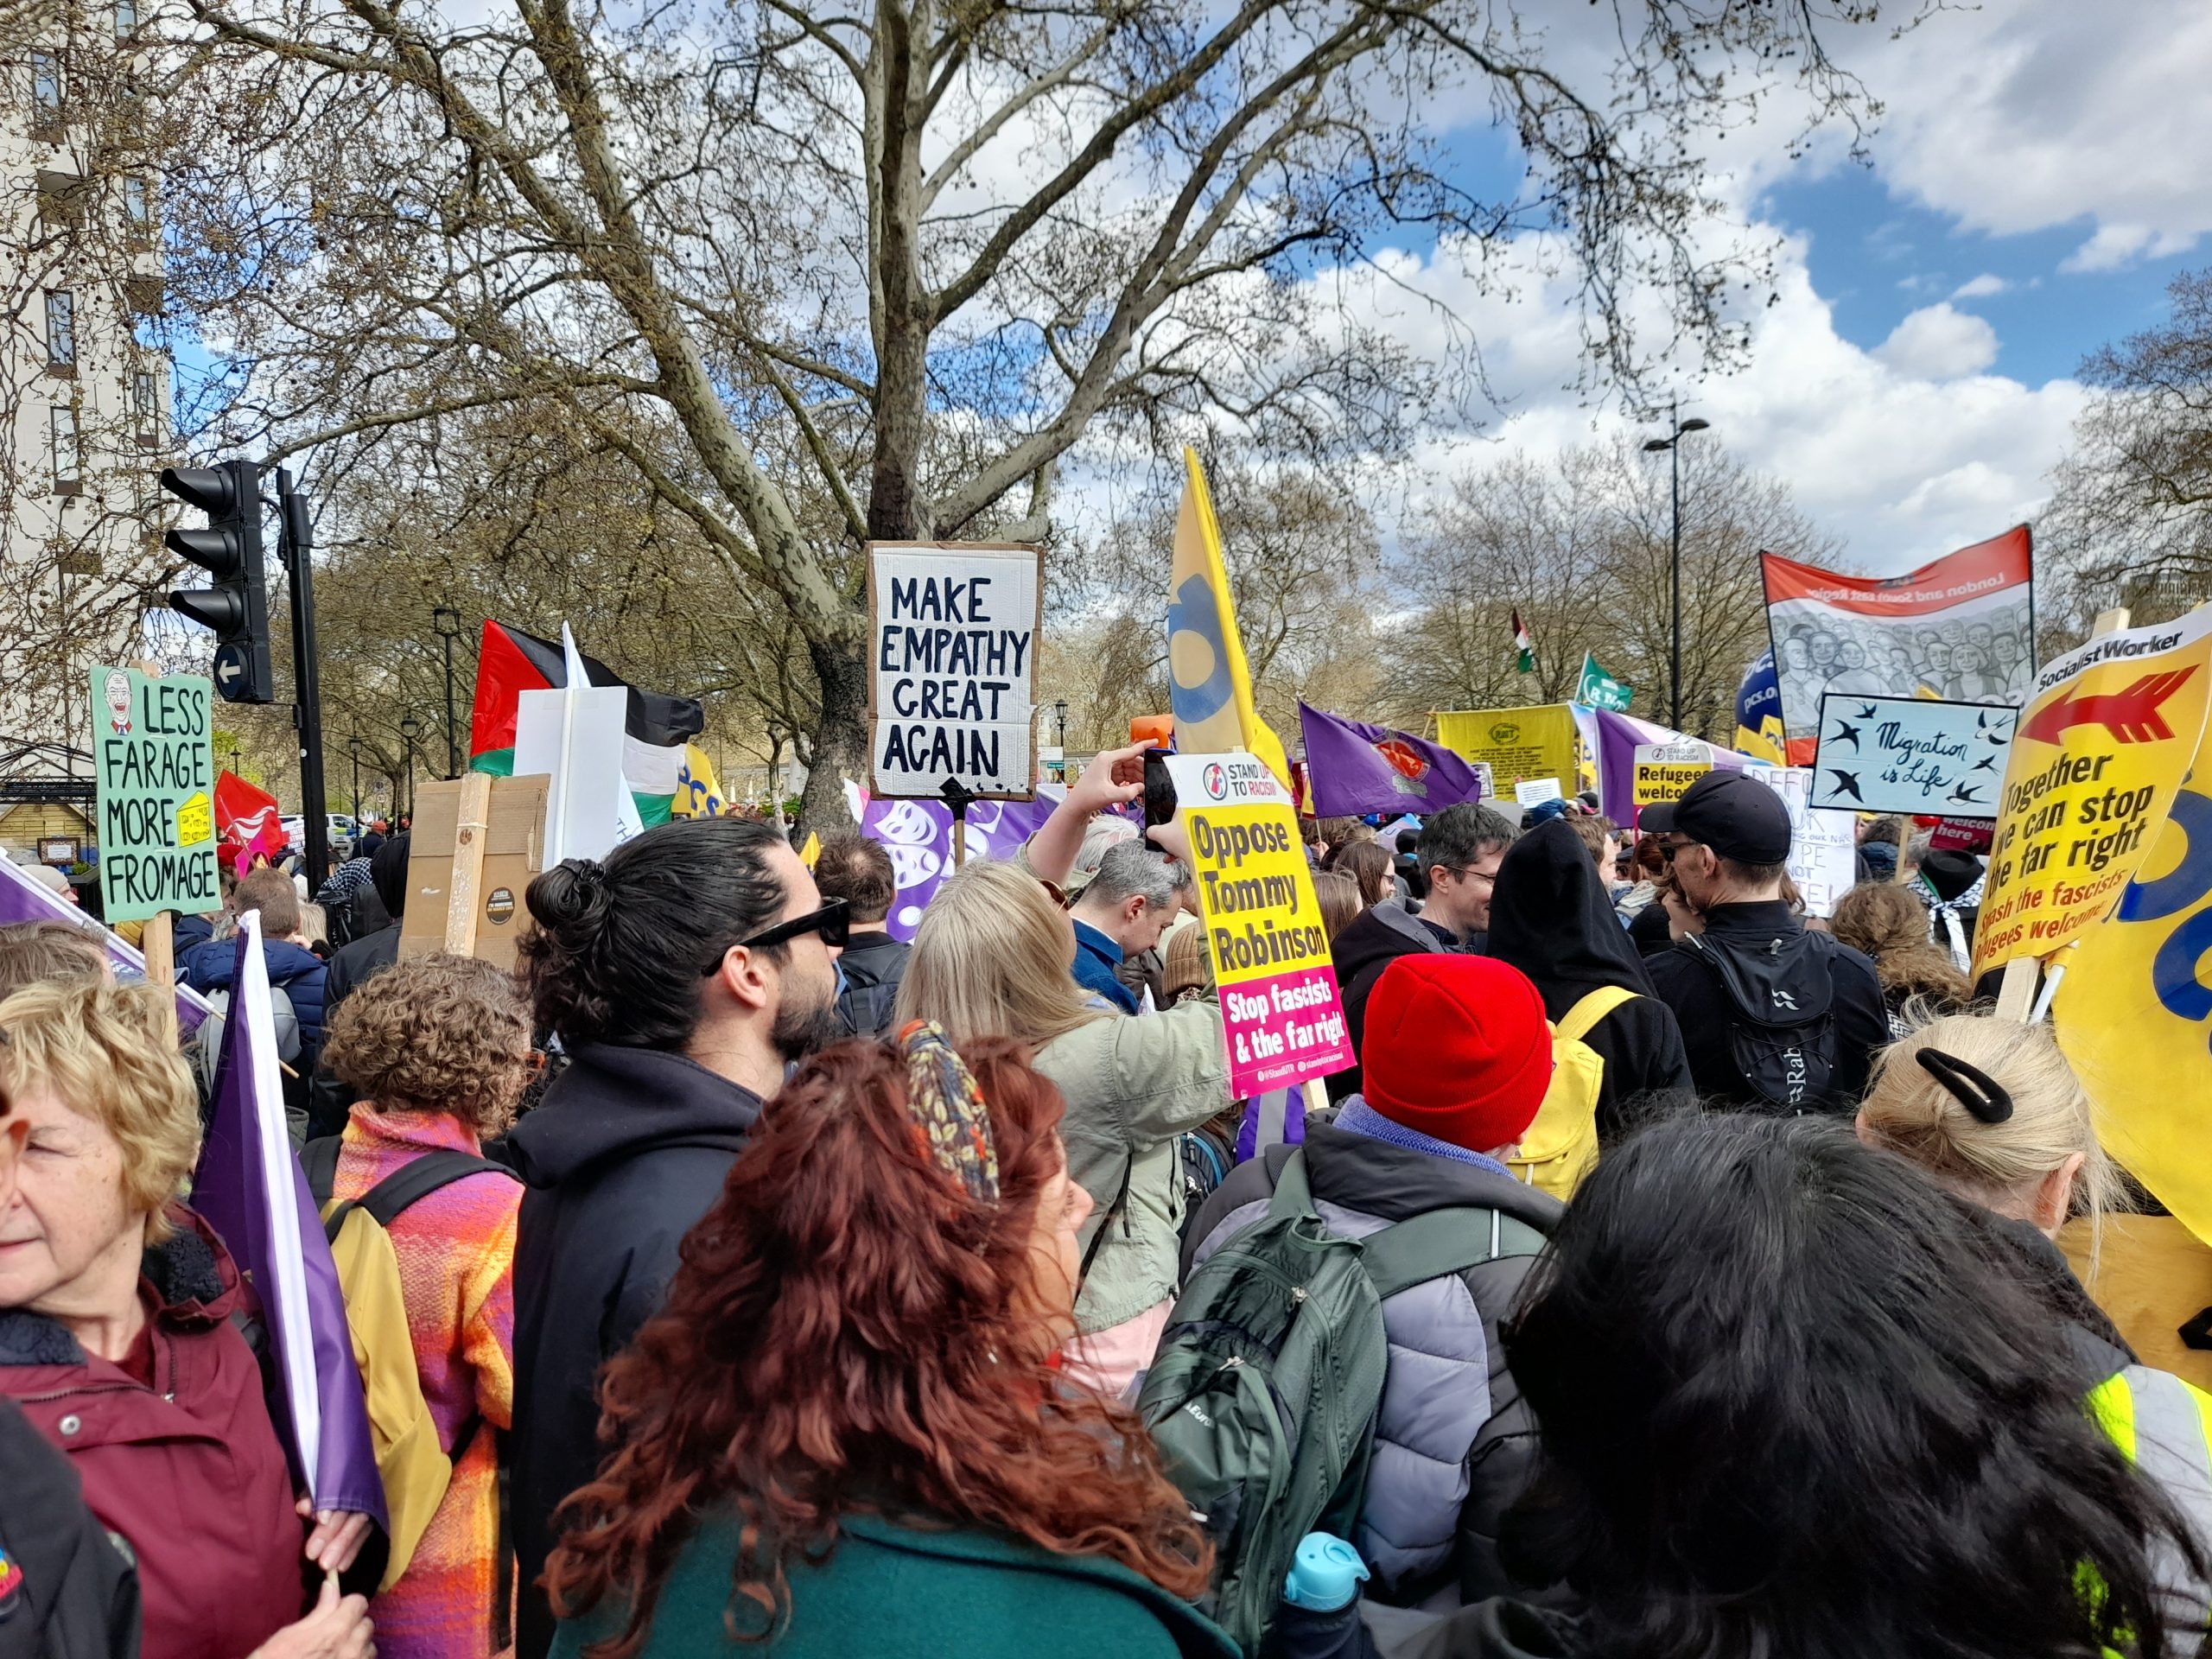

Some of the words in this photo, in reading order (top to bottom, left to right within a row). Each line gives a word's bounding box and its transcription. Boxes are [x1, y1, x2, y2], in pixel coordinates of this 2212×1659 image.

[892, 576, 991, 623] MAKE
[880, 625, 1030, 677] EMPATHY
[143, 684, 204, 736] LESS
[893, 678, 1010, 721] GREAT
[105, 739, 207, 789] FARAGE
[882, 724, 999, 777] AGAIN
[1876, 721, 1968, 766] Migration
[1228, 763, 1259, 779] STAND
[1234, 782, 1248, 797] TO
[1249, 781, 1276, 797] RACISM
[1638, 785, 1687, 798] welco
[1880, 764, 1899, 784] is
[1903, 758, 1957, 796] Life
[2005, 753, 2114, 817] Together
[107, 798, 175, 848] MORE
[1191, 815, 1290, 869] Oppose
[1936, 823, 1974, 841] here
[1995, 823, 2016, 859] we
[2023, 800, 2068, 840] can
[2078, 785, 2156, 824] stop
[106, 850, 216, 905] FROMAGE
[1987, 858, 2012, 900] the
[2018, 841, 2059, 879] far
[2067, 817, 2148, 872] right
[1201, 870, 1298, 916] Tommy
[2015, 886, 2044, 913] the
[1211, 919, 1326, 974] Robinson
[1226, 991, 1270, 1024] Stop
[1270, 976, 1333, 1014] fascists
[1236, 1032, 1252, 1065] &
[1250, 1027, 1285, 1059] the
[1285, 1018, 1315, 1051] far
[1314, 1010, 1345, 1047] right
[1783, 1046, 1807, 1086] Rab
